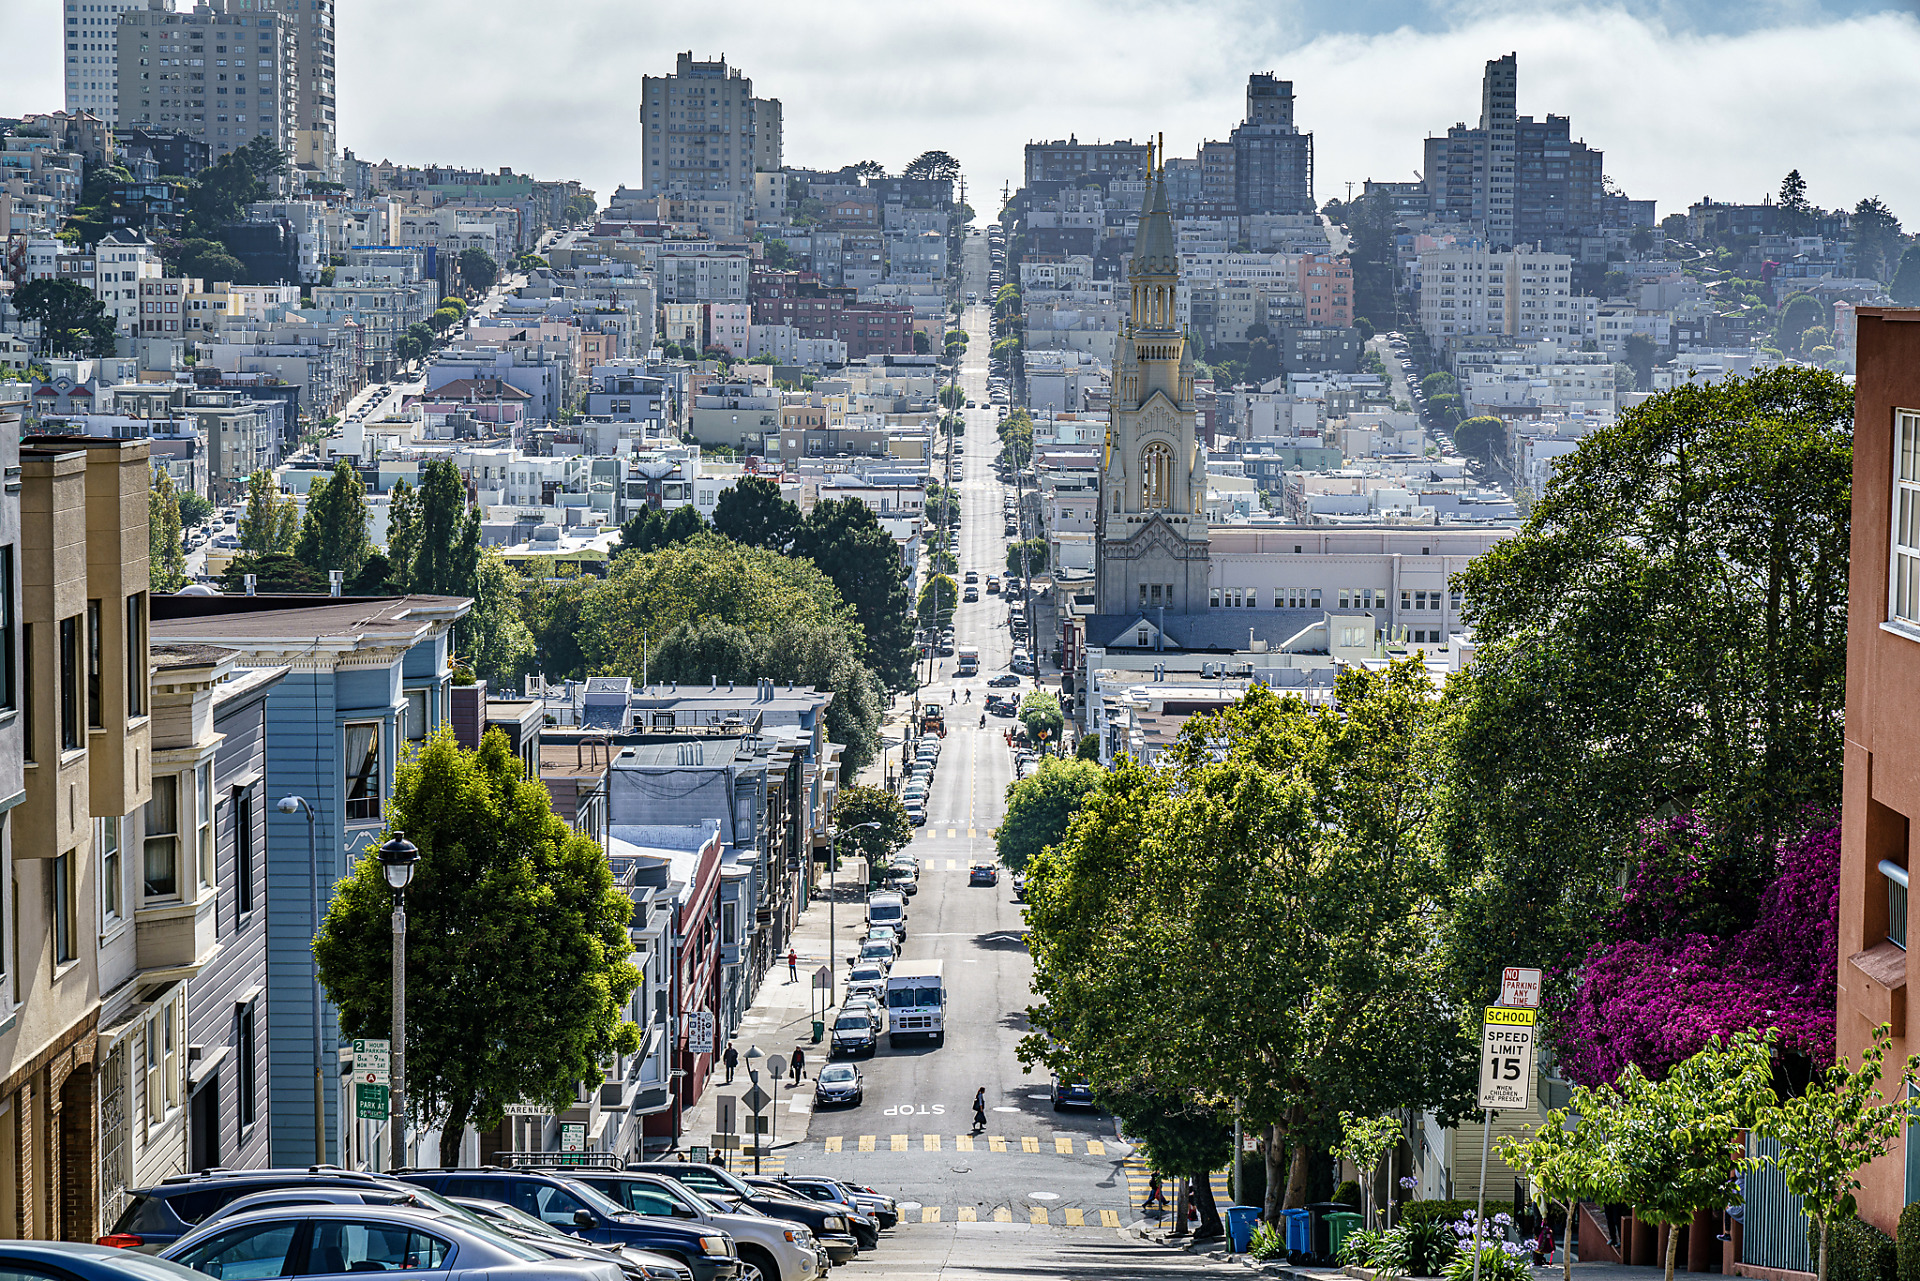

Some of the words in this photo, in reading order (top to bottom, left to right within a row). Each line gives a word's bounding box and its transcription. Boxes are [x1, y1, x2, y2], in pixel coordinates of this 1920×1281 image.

[1506, 970, 1518, 980] NO
[1507, 982, 1537, 990] PARKING
[1513, 997, 1528, 1005] TIME
[1488, 1011, 1532, 1023] SCHOOL
[1488, 1031, 1529, 1042] SPEED
[356, 1042, 362, 1051] 2
[1491, 1045, 1524, 1055] LIMIT
[1491, 1058, 1521, 1080] 15
[360, 1101, 375, 1109] PARK
[883, 1104, 946, 1116] STOP
